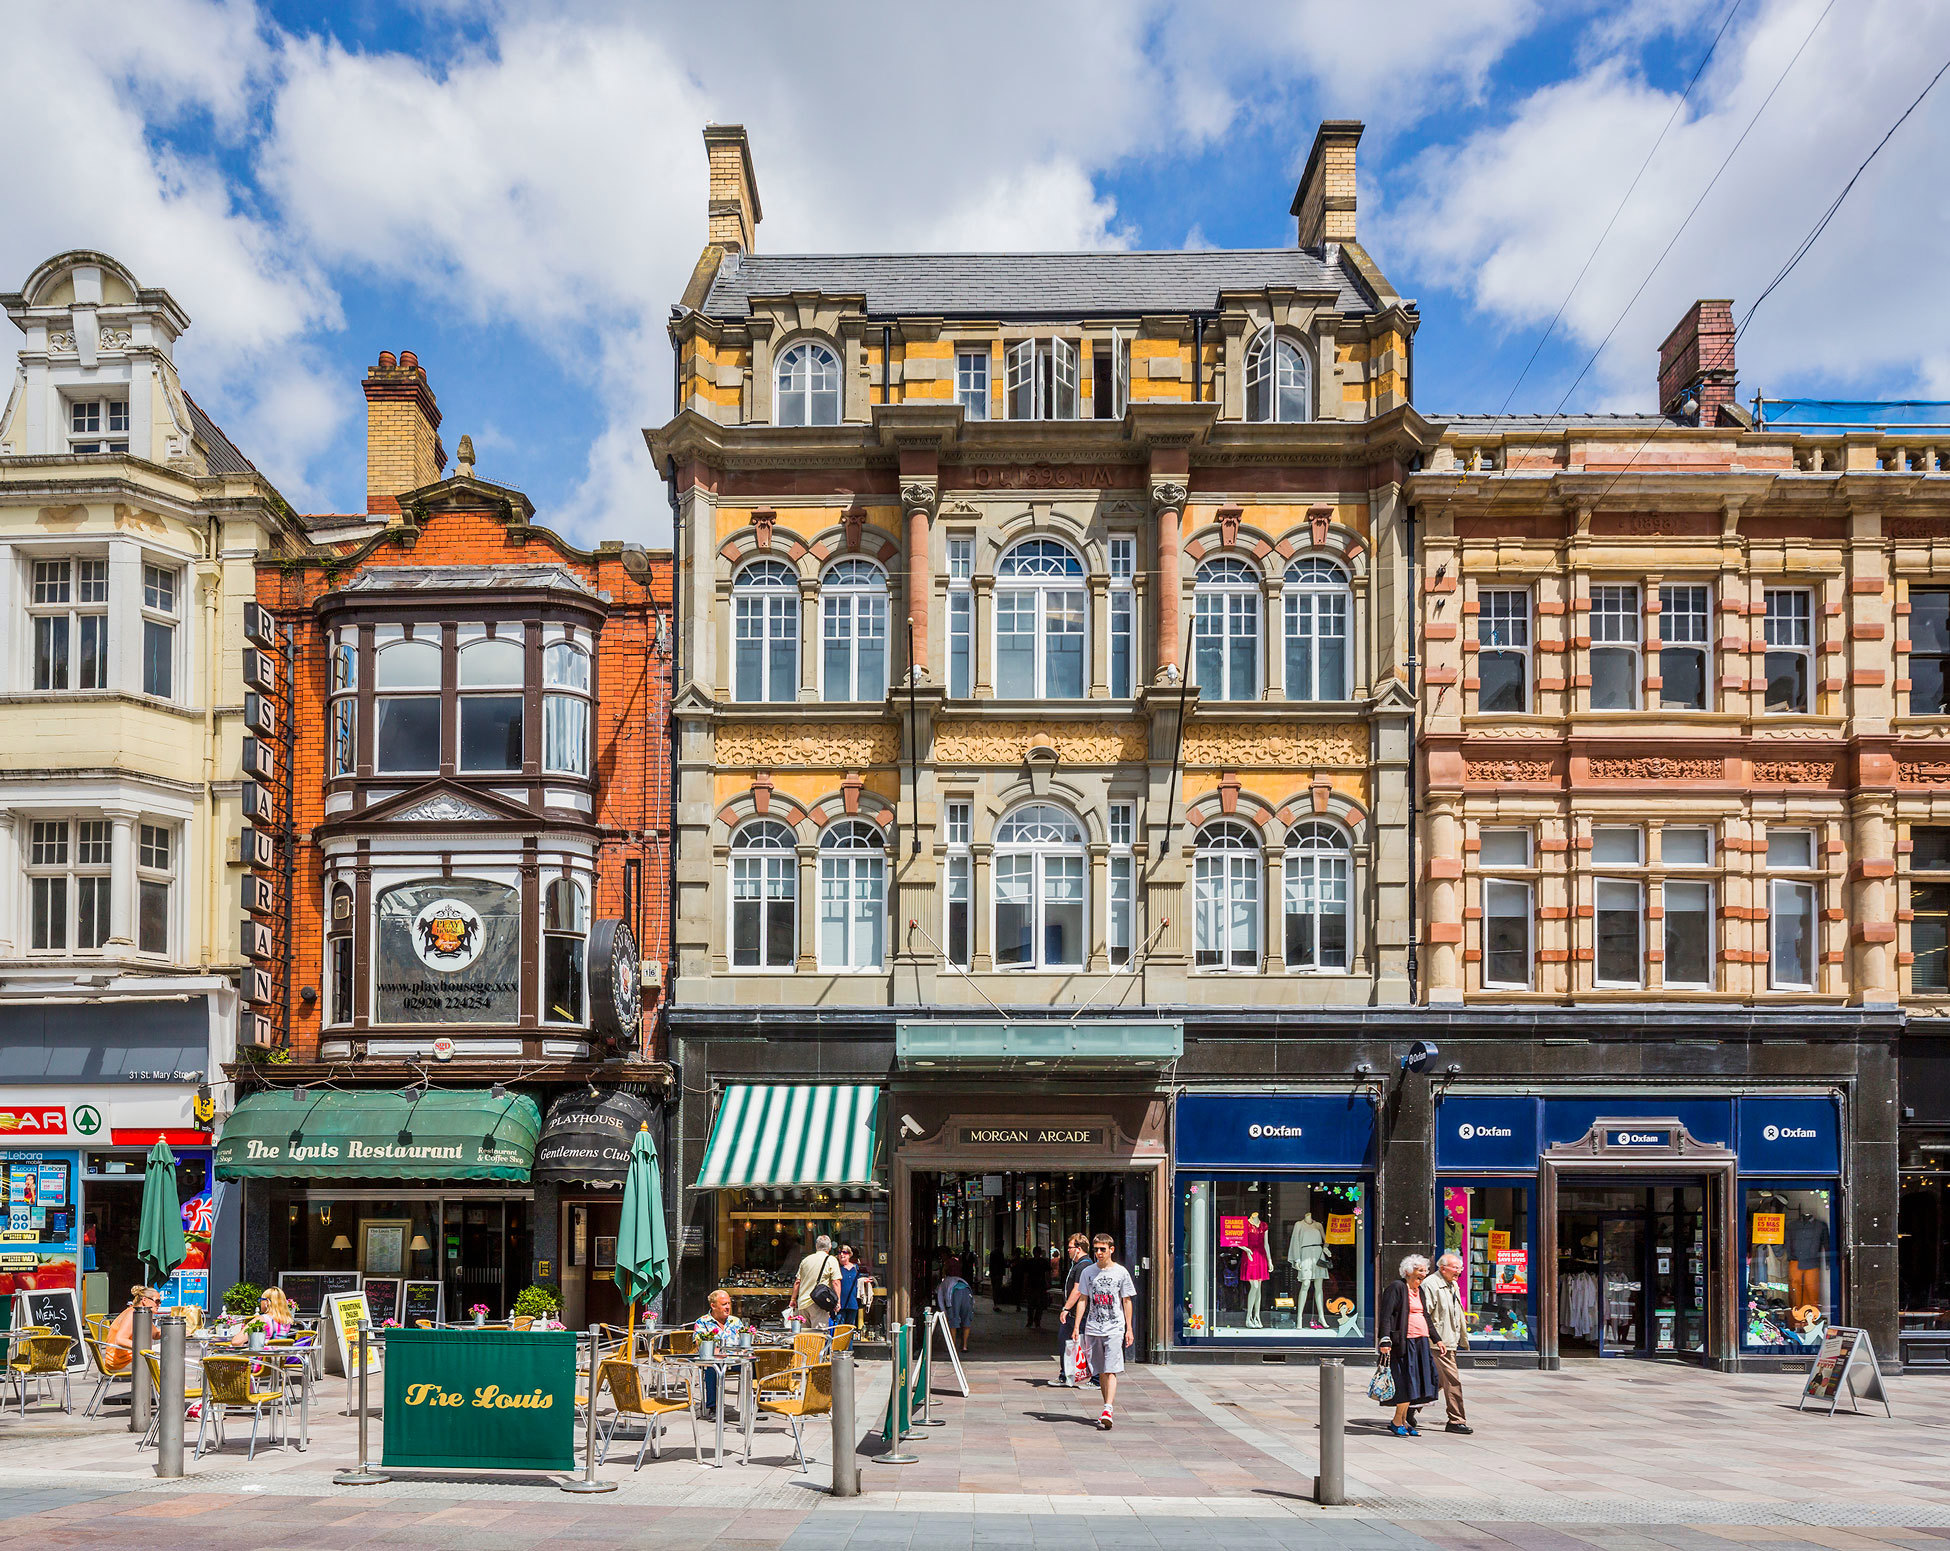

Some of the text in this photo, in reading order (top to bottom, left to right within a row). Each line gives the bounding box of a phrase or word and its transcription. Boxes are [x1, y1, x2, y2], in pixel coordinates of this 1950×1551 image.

[403, 997, 491, 1010] 02920 224254
[129, 1071, 138, 1079] 31
[140, 1070, 151, 1079] St.
[153, 1070, 172, 1081] Mary
[551, 1114, 624, 1129] PLAYHOUSE
[971, 1130, 1091, 1142] MORGAN ARCADE
[1263, 1125, 1302, 1137] Oxfam
[1476, 1126, 1511, 1137] Oxfam
[1780, 1127, 1817, 1138] Oxfam
[1630, 1134, 1659, 1143] Oxfam
[8, 1151, 43, 1160] Lebara
[247, 1139, 463, 1161] The Louis Restaurant
[478, 1146, 518, 1157] Restaurant
[541, 1145, 631, 1162] Gentlemens Club
[484, 1154, 509, 1164] Coffee
[509, 1156, 524, 1165] Shop
[43, 1297, 54, 1309] 2
[36, 1308, 68, 1321] MEALS
[471, 1384, 554, 1410] Louis
